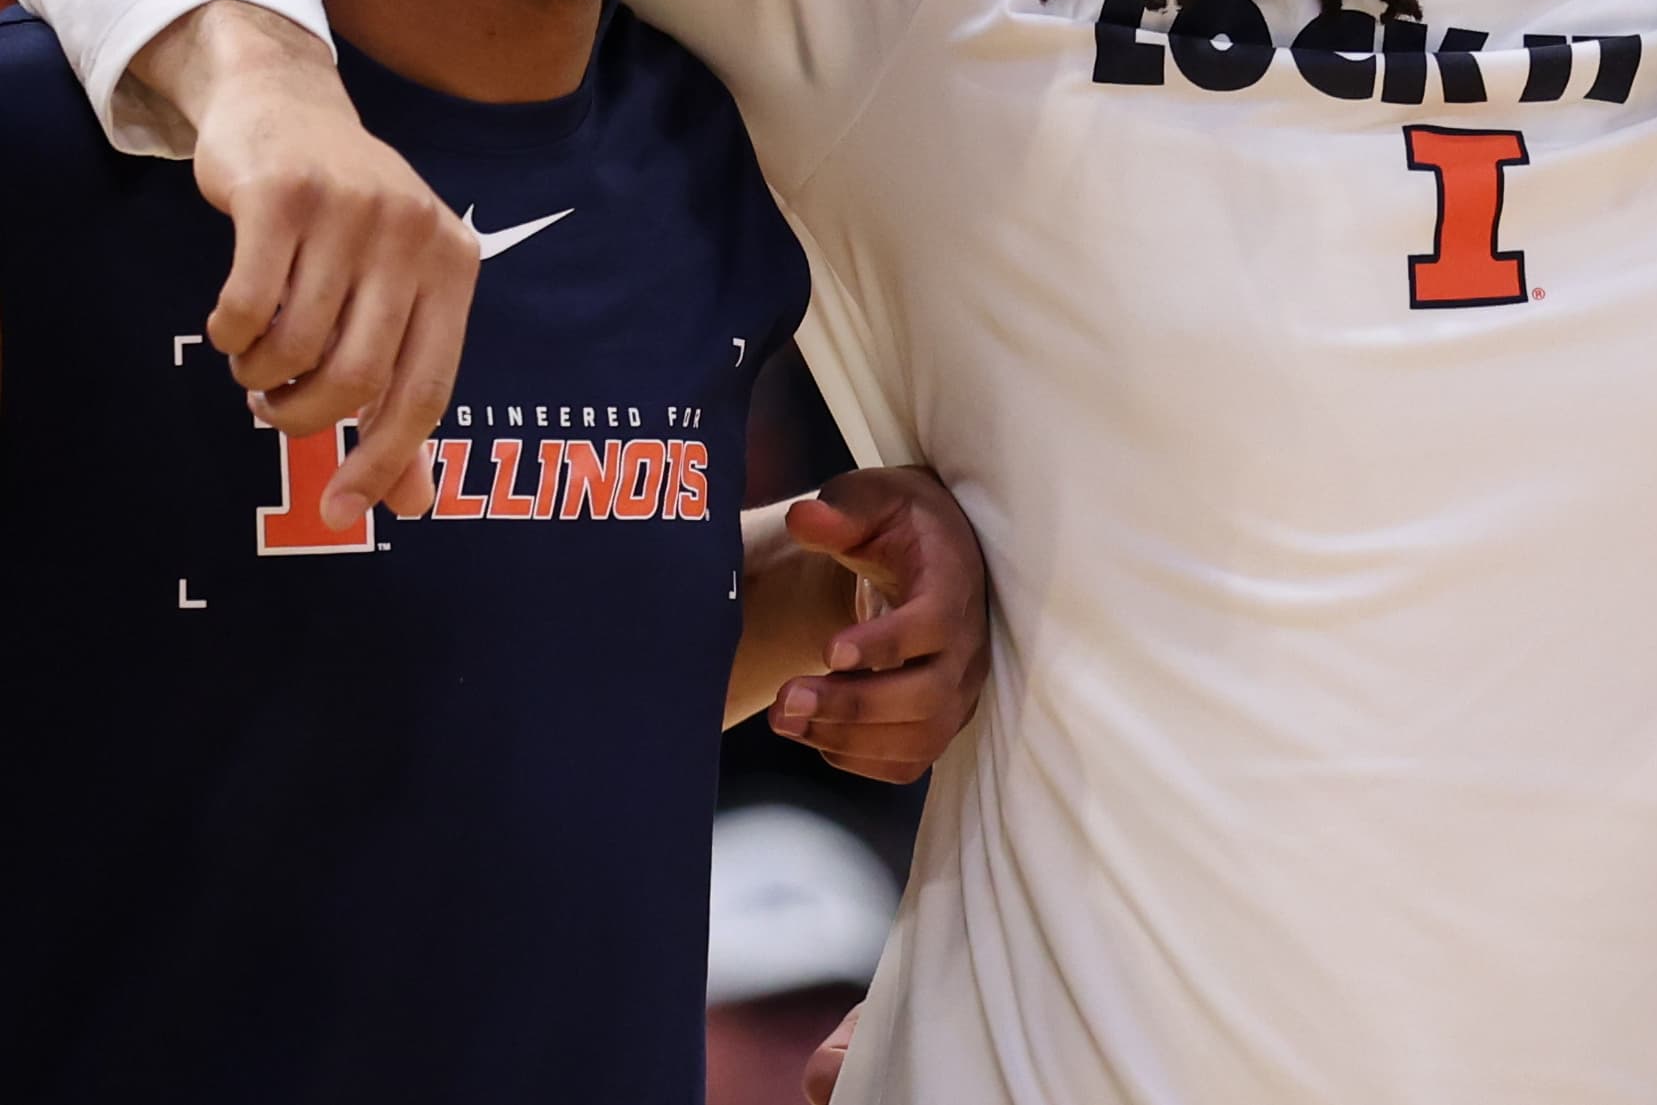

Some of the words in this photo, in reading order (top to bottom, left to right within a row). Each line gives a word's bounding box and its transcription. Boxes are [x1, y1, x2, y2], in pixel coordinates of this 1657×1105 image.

[1402, 124, 1530, 310] I
[435, 406, 641, 427] GINEERED
[668, 406, 701, 428] FOR
